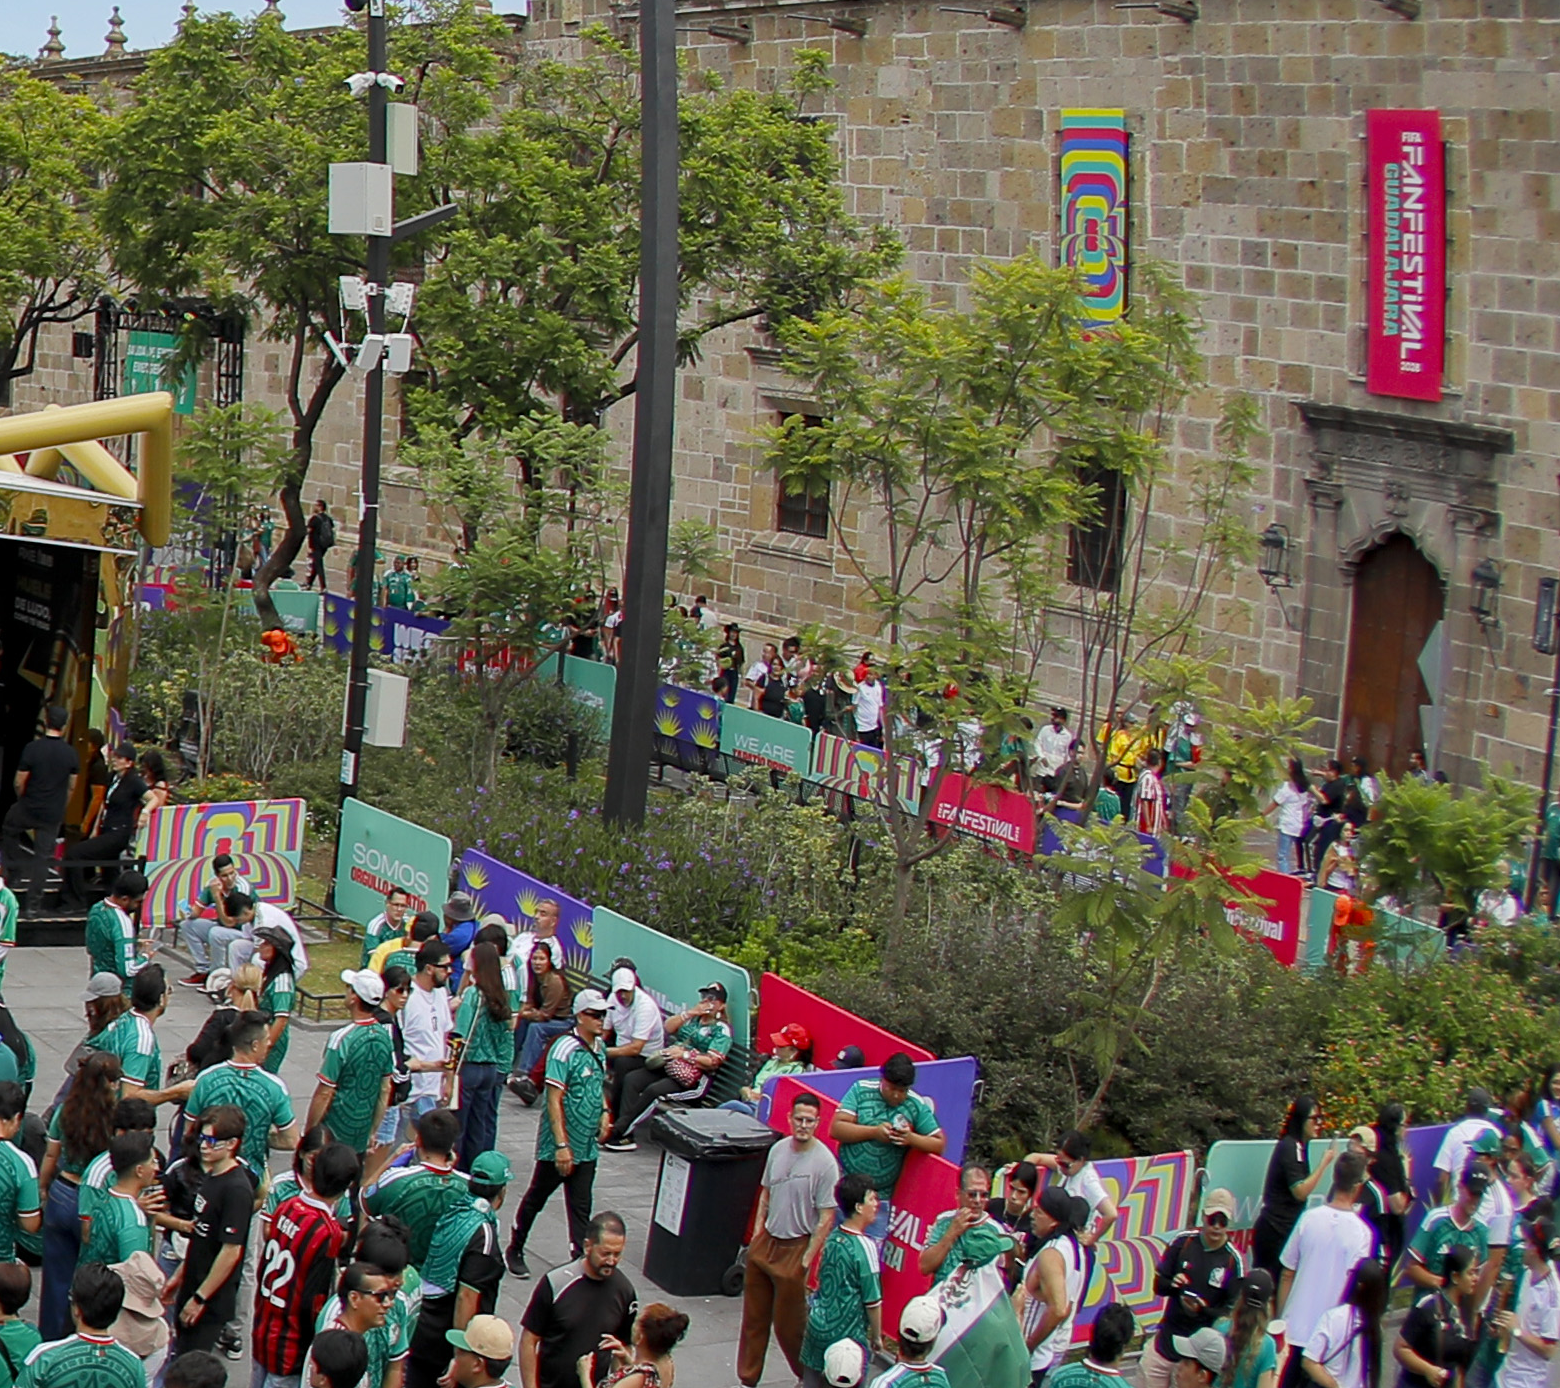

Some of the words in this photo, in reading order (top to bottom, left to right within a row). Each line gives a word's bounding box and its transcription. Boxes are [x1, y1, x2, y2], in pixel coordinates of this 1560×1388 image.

[1383, 163, 1401, 337] GUADALAJARA
[734, 733, 760, 753] WE
[760, 740, 796, 765] ARE
[353, 842, 430, 896] SOMOS
[260, 1238, 296, 1308] 22
